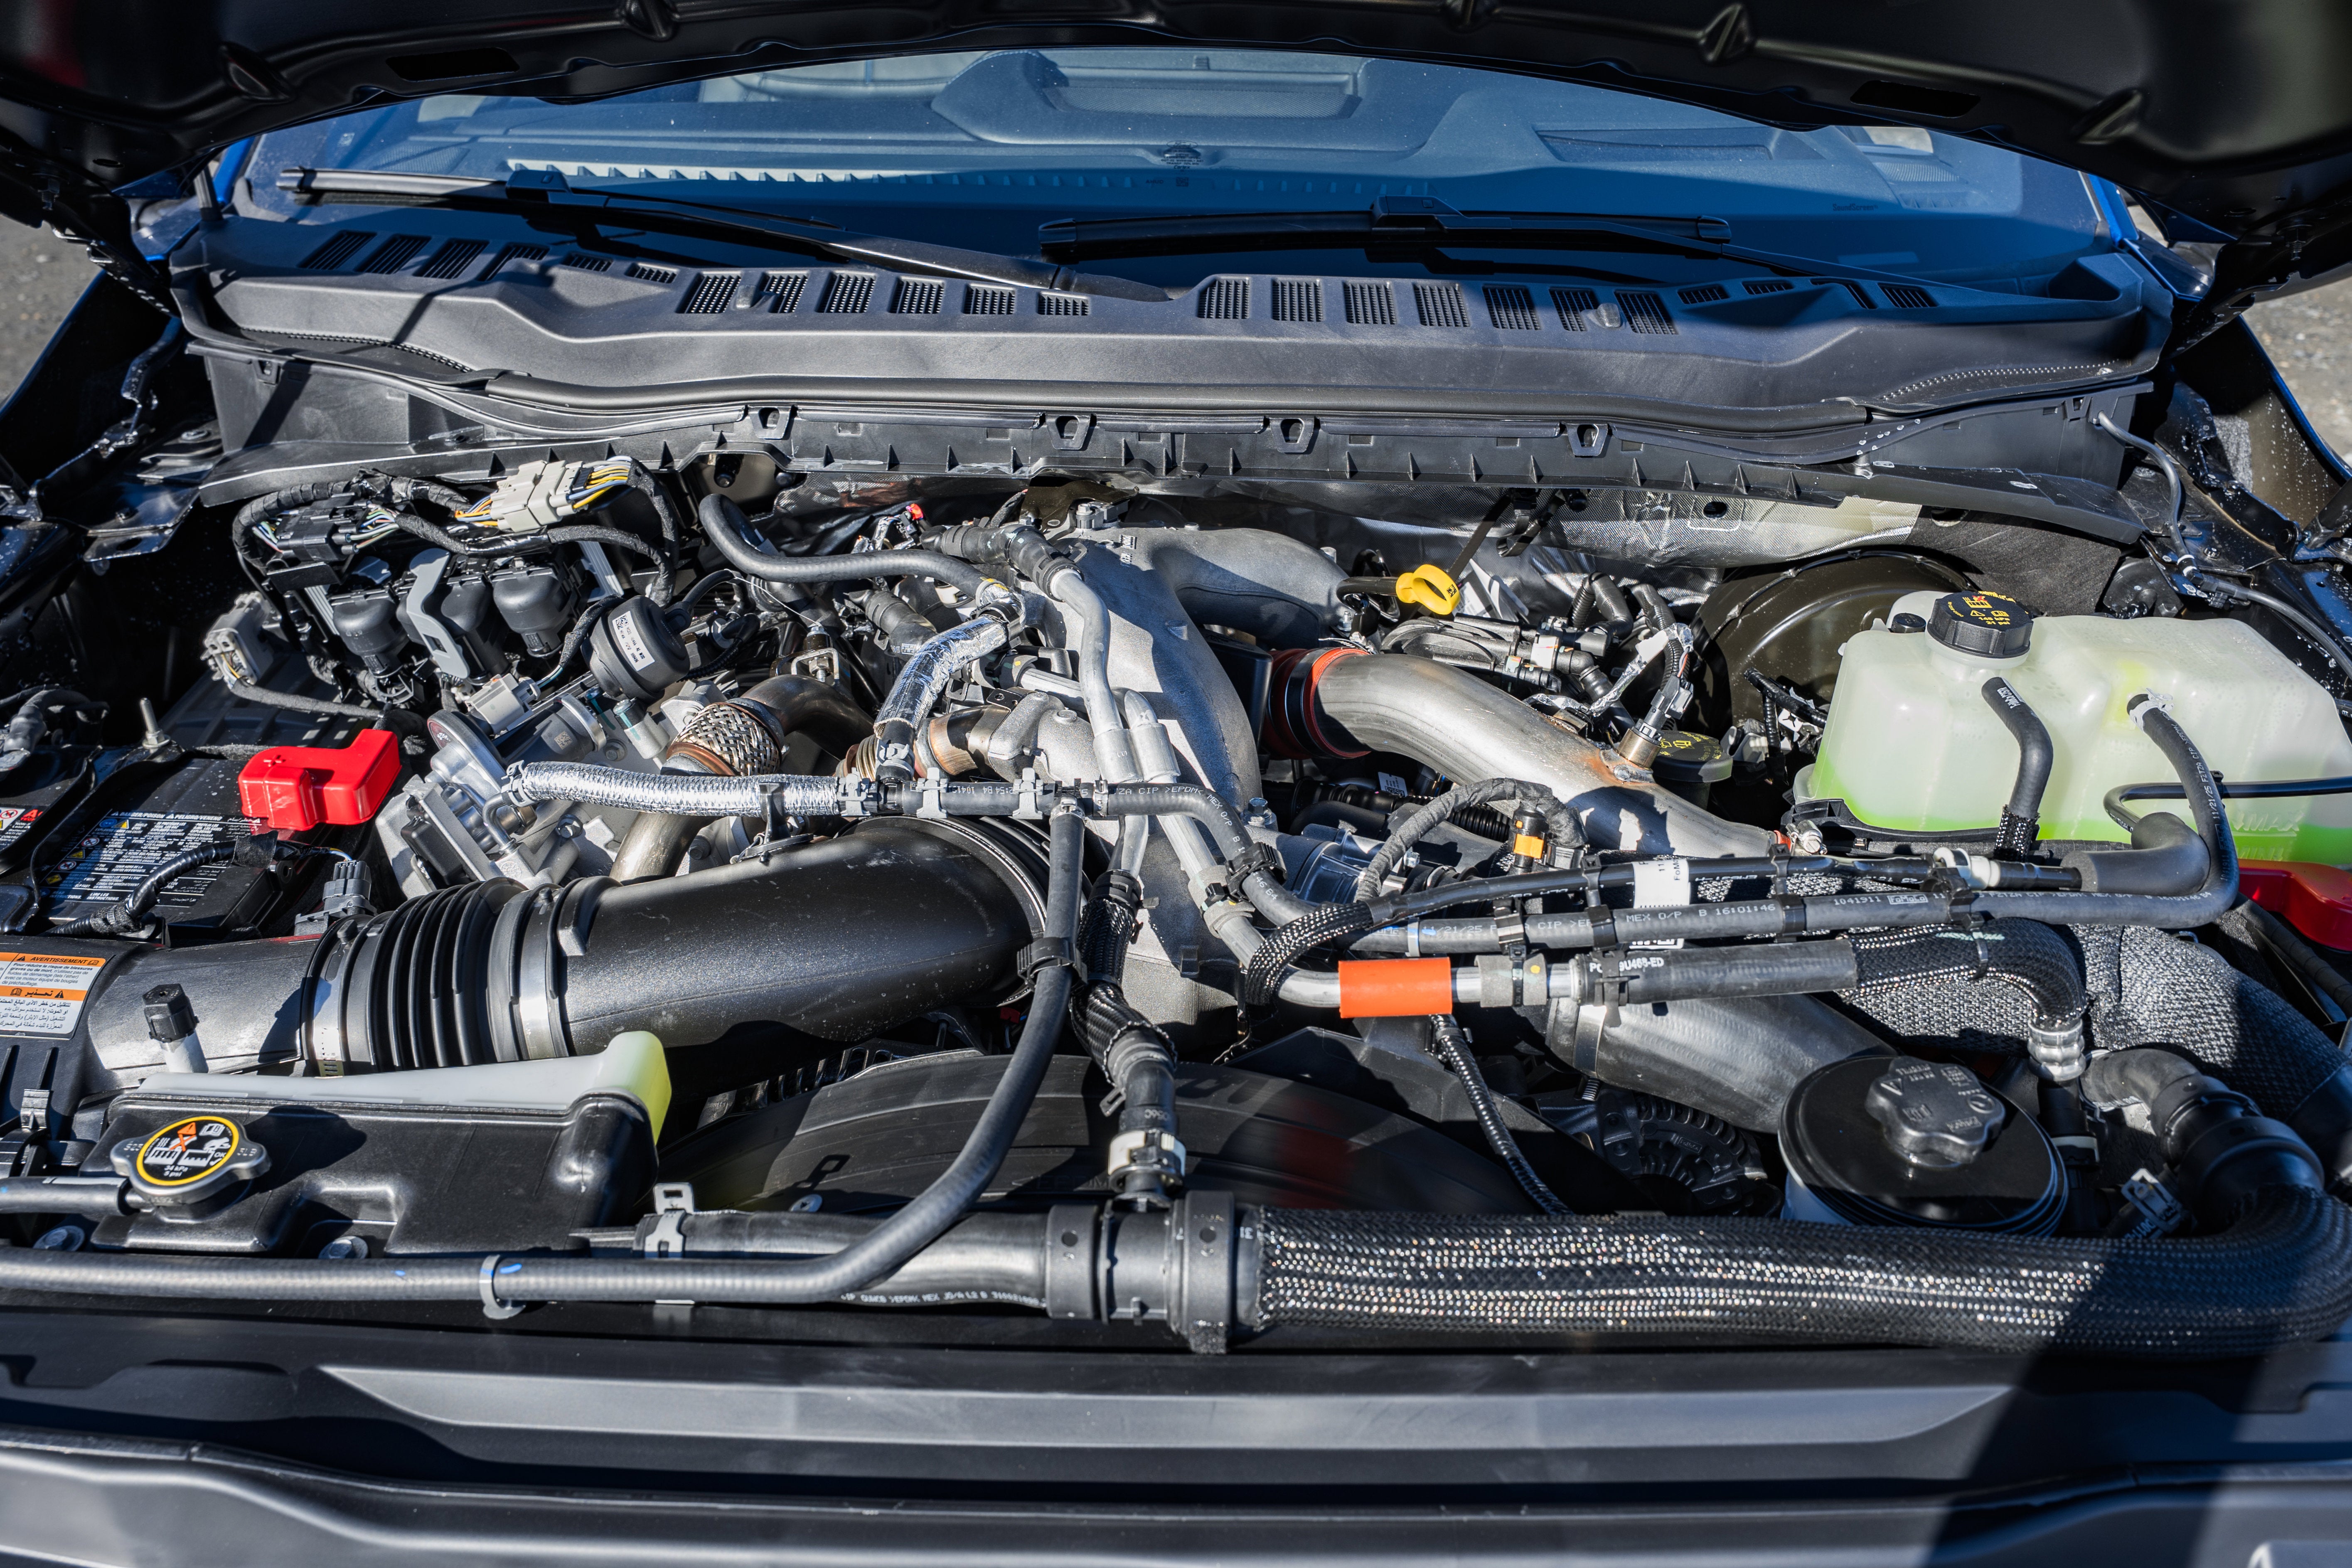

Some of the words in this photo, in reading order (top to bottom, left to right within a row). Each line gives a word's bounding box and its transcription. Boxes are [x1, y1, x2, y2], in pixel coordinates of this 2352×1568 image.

[1207, 794, 1223, 810] MEX
[1626, 913, 1651, 923] MEX
[1699, 909, 1707, 917] B
[1716, 903, 1776, 916] 16:01:46
[1834, 896, 1881, 906] 1041911
